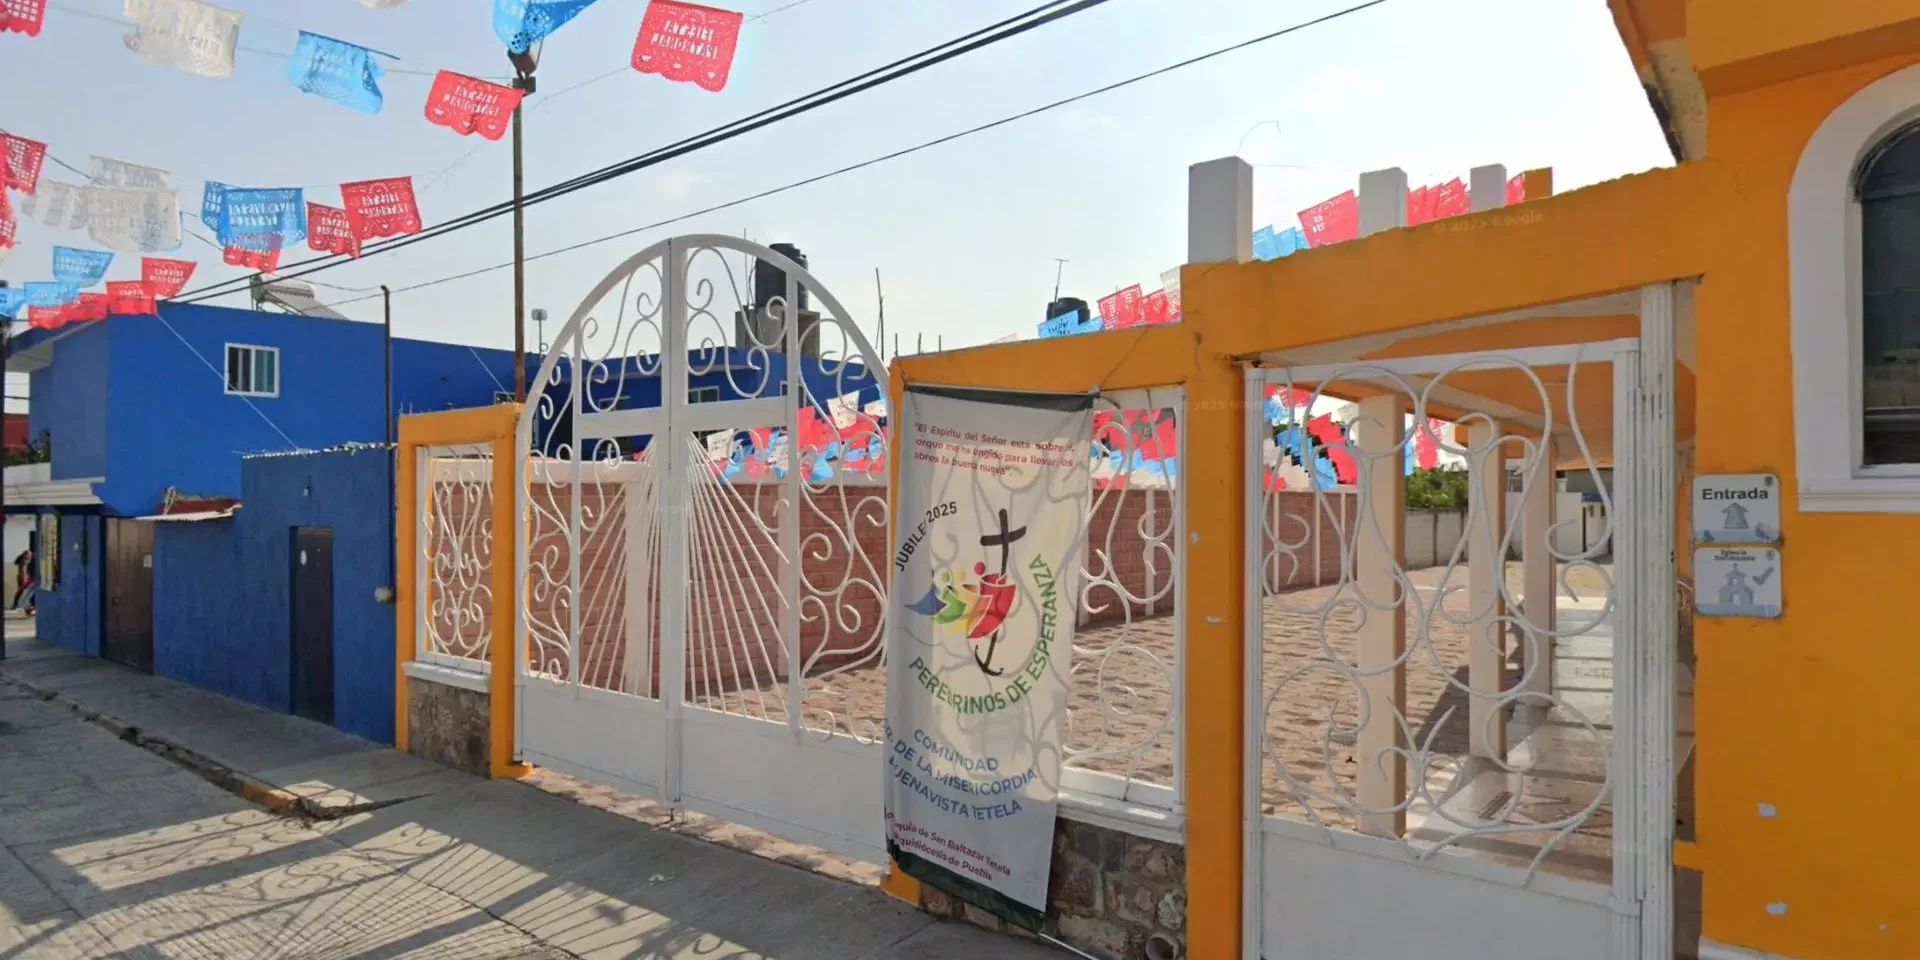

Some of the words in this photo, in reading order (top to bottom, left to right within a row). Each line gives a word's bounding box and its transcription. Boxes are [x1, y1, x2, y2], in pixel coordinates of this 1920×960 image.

[964, 431, 978, 441] del
[981, 432, 1006, 446] Señor
[1005, 453, 1028, 464] para
[1702, 487, 1769, 500] Entrada
[895, 517, 927, 572] JUBILE
[926, 501, 957, 523] 2025
[1005, 674, 1033, 704] DE
[1026, 554, 1057, 681] ESPERANZA
[894, 739, 917, 762] DE
[916, 755, 933, 777] LA
[914, 729, 999, 772] COMUNDAD
